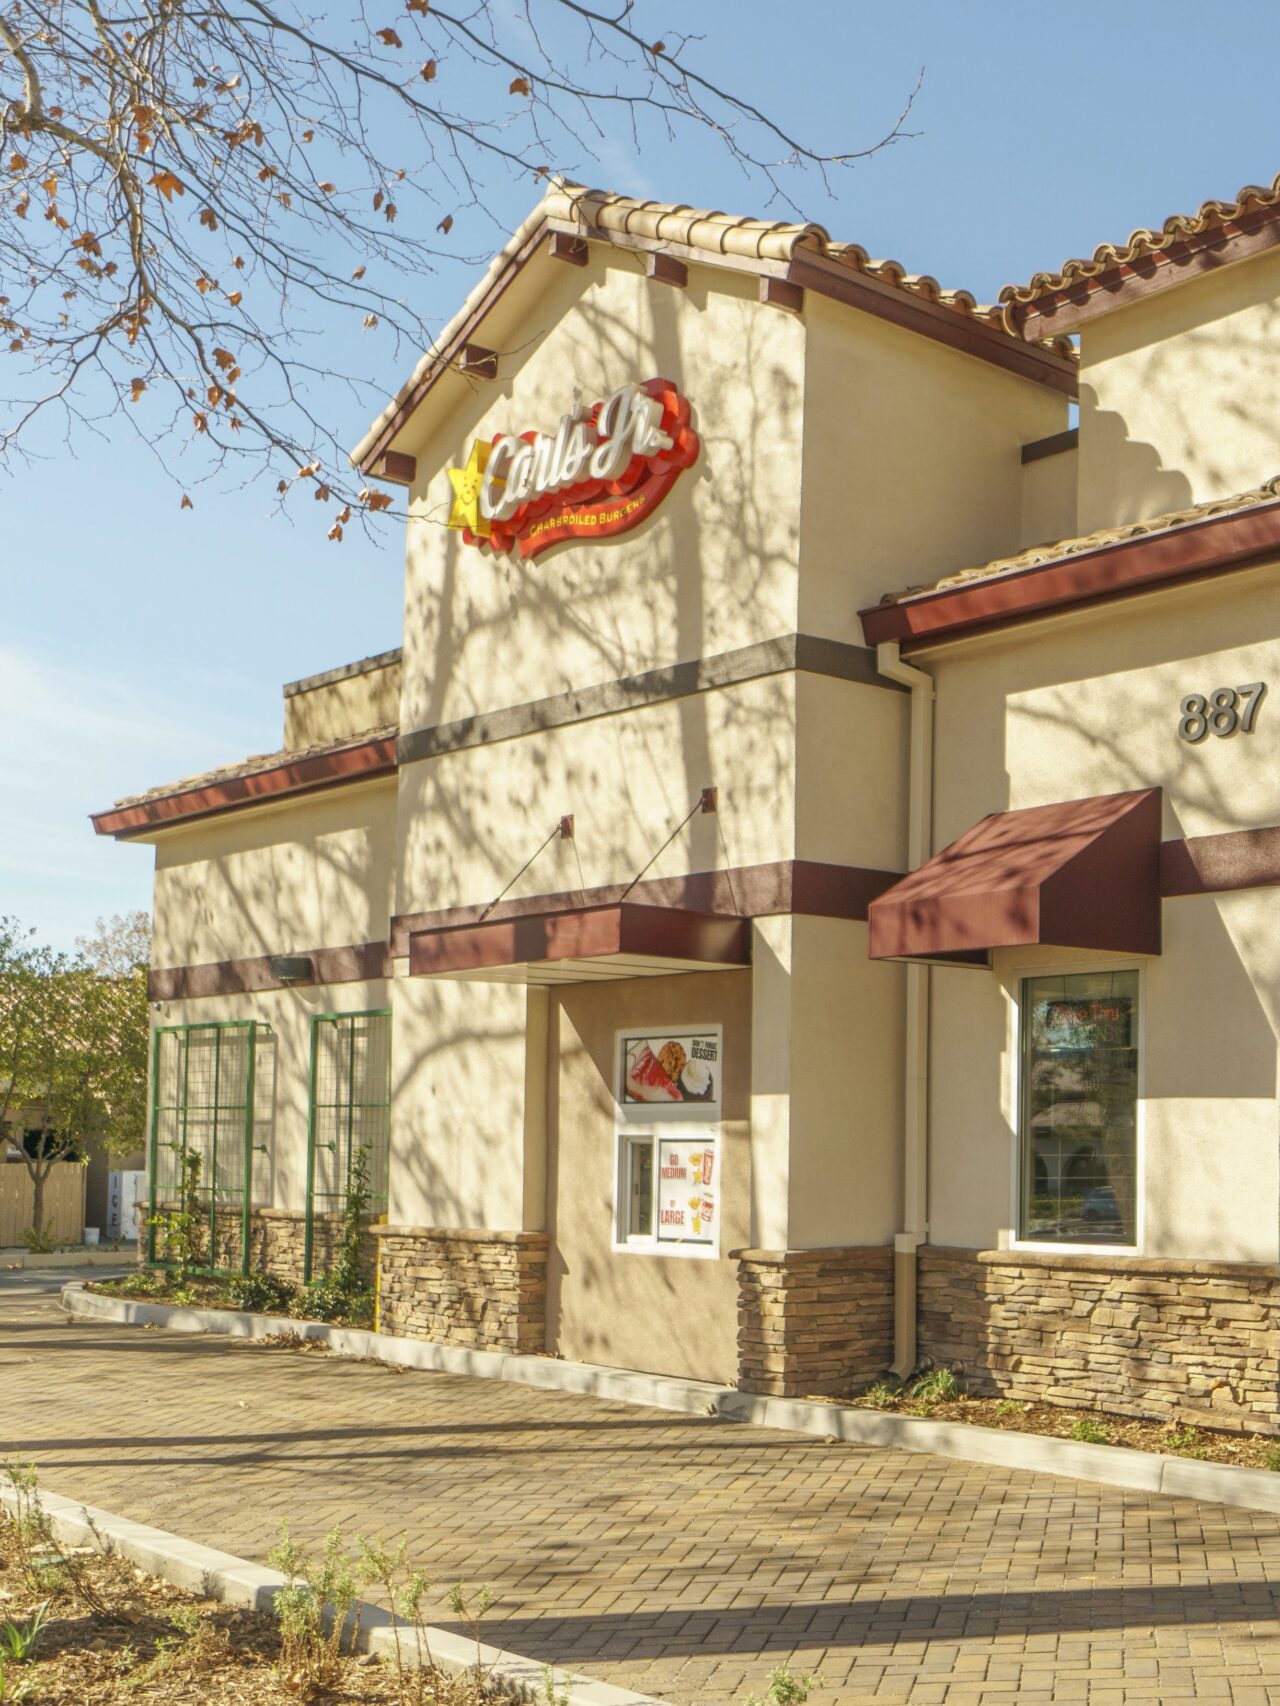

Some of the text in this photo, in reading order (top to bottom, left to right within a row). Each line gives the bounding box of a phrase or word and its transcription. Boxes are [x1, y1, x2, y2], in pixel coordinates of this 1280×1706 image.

[480, 382, 669, 519] Carl's Jr.
[529, 514, 597, 537] CHARBROILED
[1178, 682, 1265, 742] 887
[691, 1046, 718, 1062] DESSERT
[669, 1153, 679, 1165] GO
[661, 1167, 687, 1180] MEDIUM
[660, 1209, 686, 1225] LARGE
